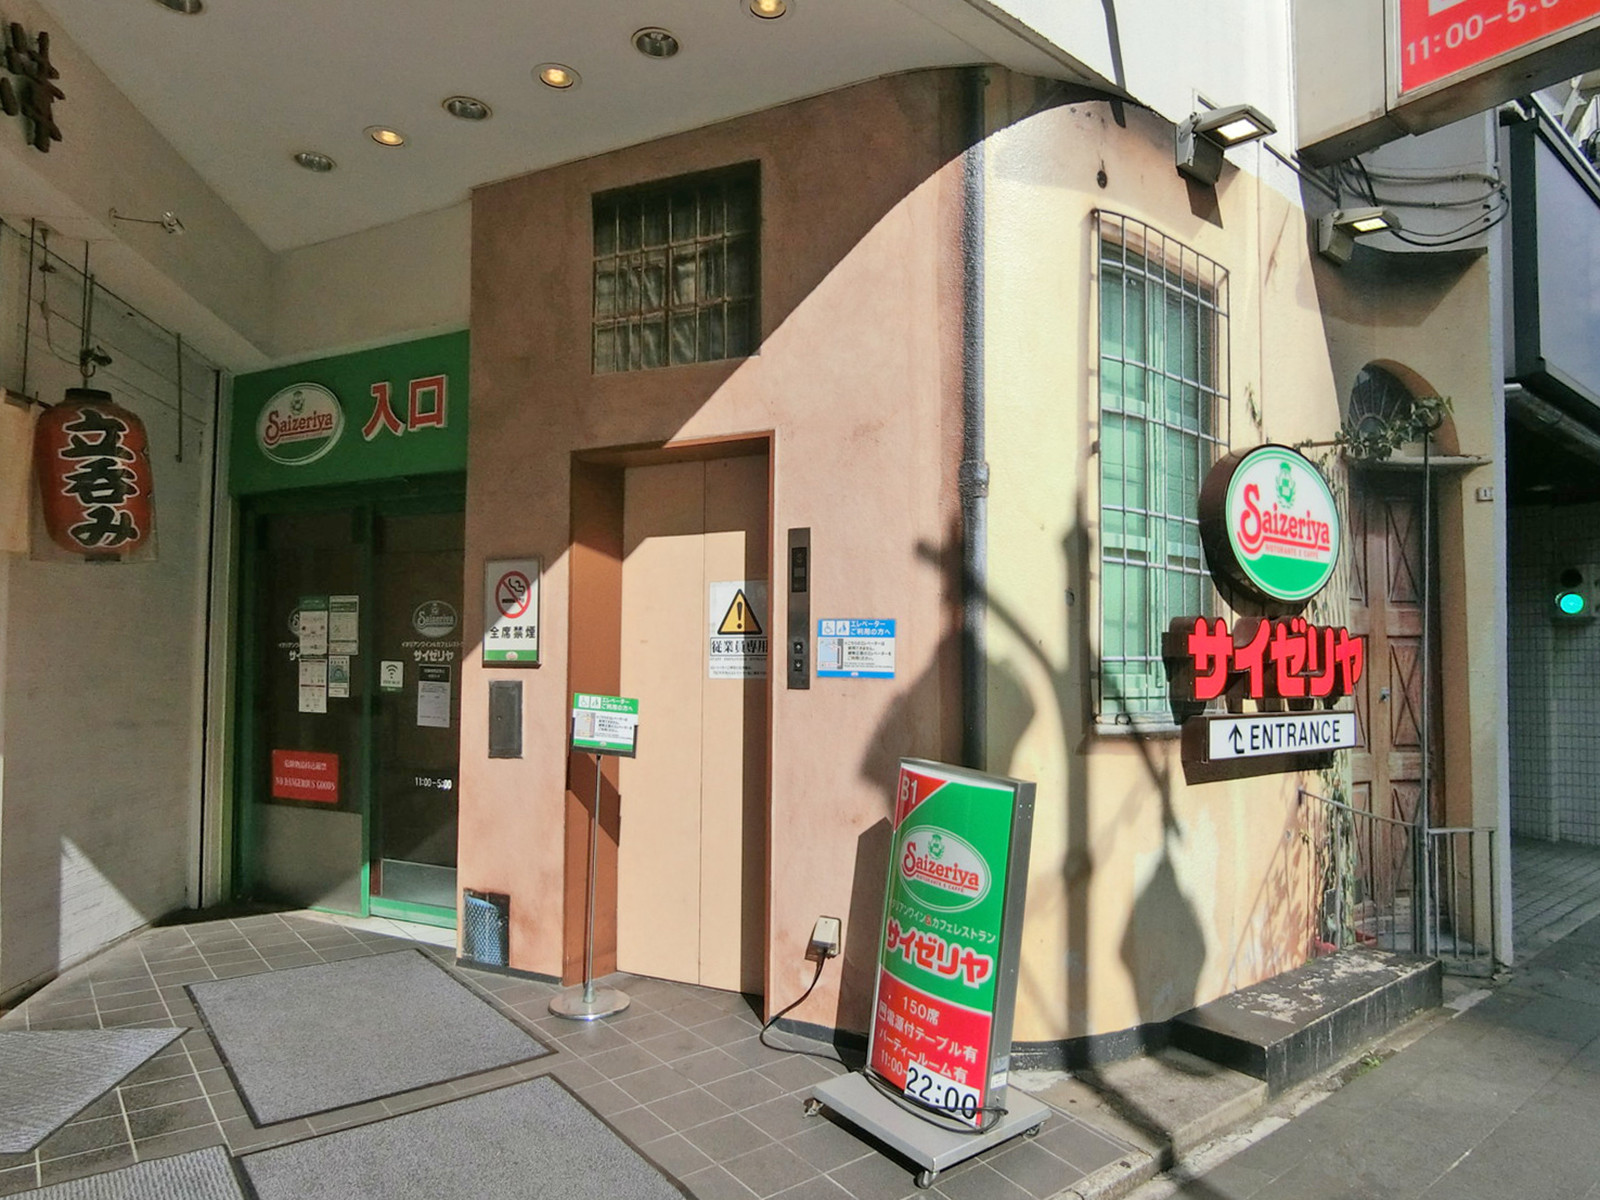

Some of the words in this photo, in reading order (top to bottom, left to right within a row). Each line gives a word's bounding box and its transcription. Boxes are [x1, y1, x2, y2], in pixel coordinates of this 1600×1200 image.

[362, 374, 447, 441] 入口
[263, 410, 333, 446] Saizeriya
[60, 407, 140, 549] 立呑み
[1238, 484, 1331, 554] Saizeriya
[490, 626, 536, 639] 全席禁煙
[850, 620, 886, 628] エレベーター
[850, 627, 891, 636] ご利用の方へ
[413, 649, 454, 661] サイゼリヤ
[711, 639, 768, 653] 従業員専用
[1188, 616, 1365, 700] サイゼリヤ
[1248, 718, 1342, 751] ENTRANCE
[901, 776, 918, 805] B1
[902, 842, 980, 892] Saizeriya
[886, 918, 993, 988] サイゼリヤ
[902, 995, 940, 1026] 150席
[906, 1066, 978, 1120] 22:00
